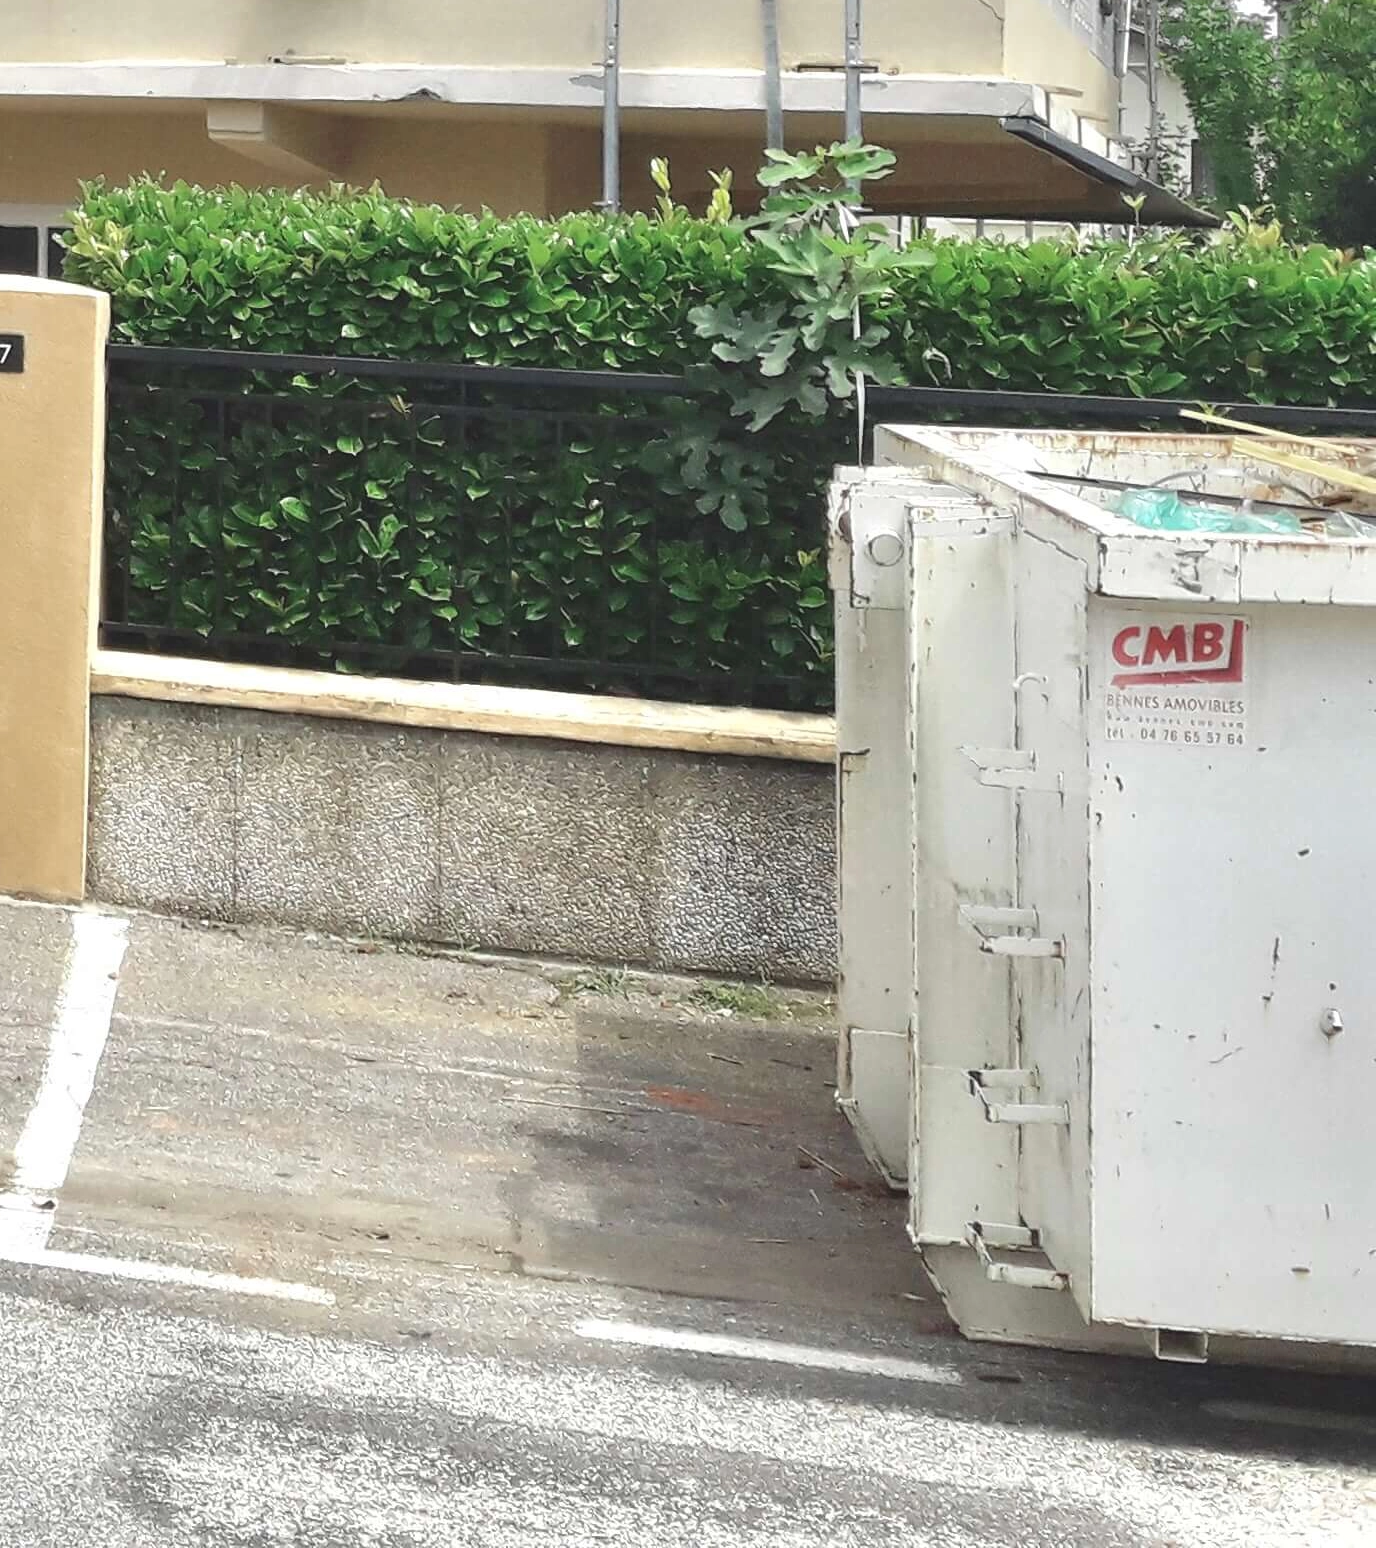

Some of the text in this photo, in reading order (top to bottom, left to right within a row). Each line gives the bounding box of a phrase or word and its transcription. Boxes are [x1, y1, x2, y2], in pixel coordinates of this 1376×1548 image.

[1112, 622, 1225, 667] CMB
[1107, 693, 1245, 715] BENNES AMOVIBLES
[1140, 727, 1156, 740] 04
[1184, 730, 1199, 743] 65
[1227, 732, 1244, 745] 64
